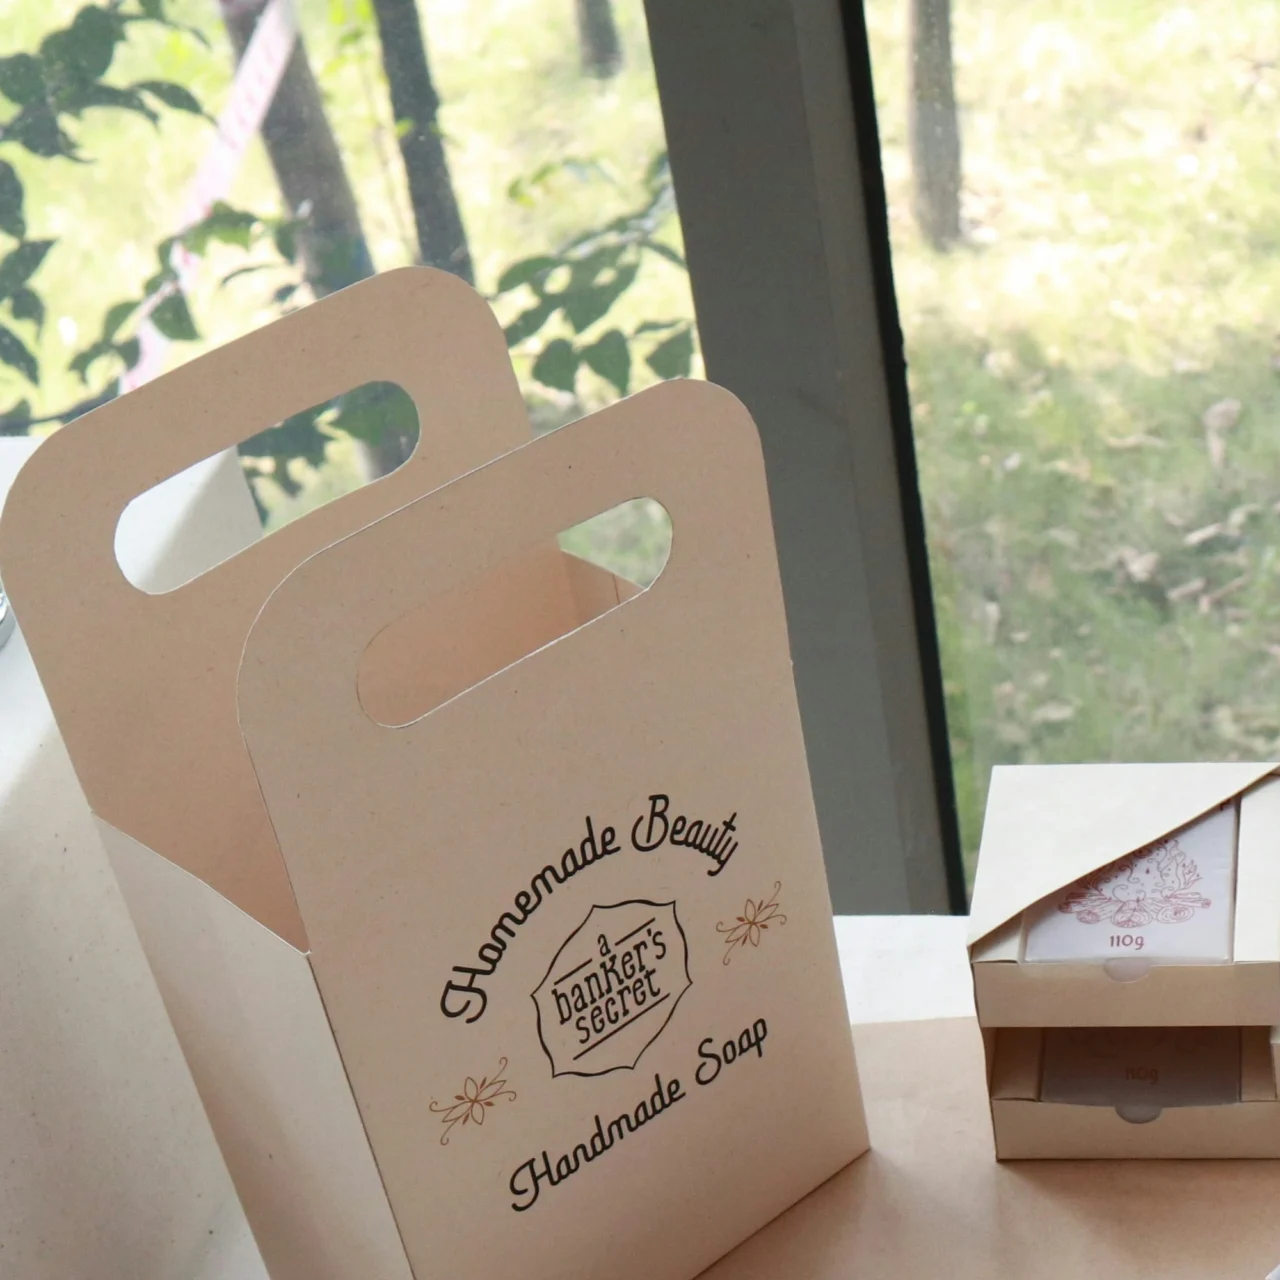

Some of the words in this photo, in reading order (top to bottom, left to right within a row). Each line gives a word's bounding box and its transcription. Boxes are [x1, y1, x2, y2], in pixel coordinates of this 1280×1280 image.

[440, 816, 621, 1024] Homemade
[631, 794, 738, 876] Beauty
[597, 933, 611, 957] a
[1109, 934, 1145, 951] 110g
[574, 969, 661, 1044] secret
[509, 1073, 686, 1212] Handmade
[695, 1017, 768, 1085] Soap
